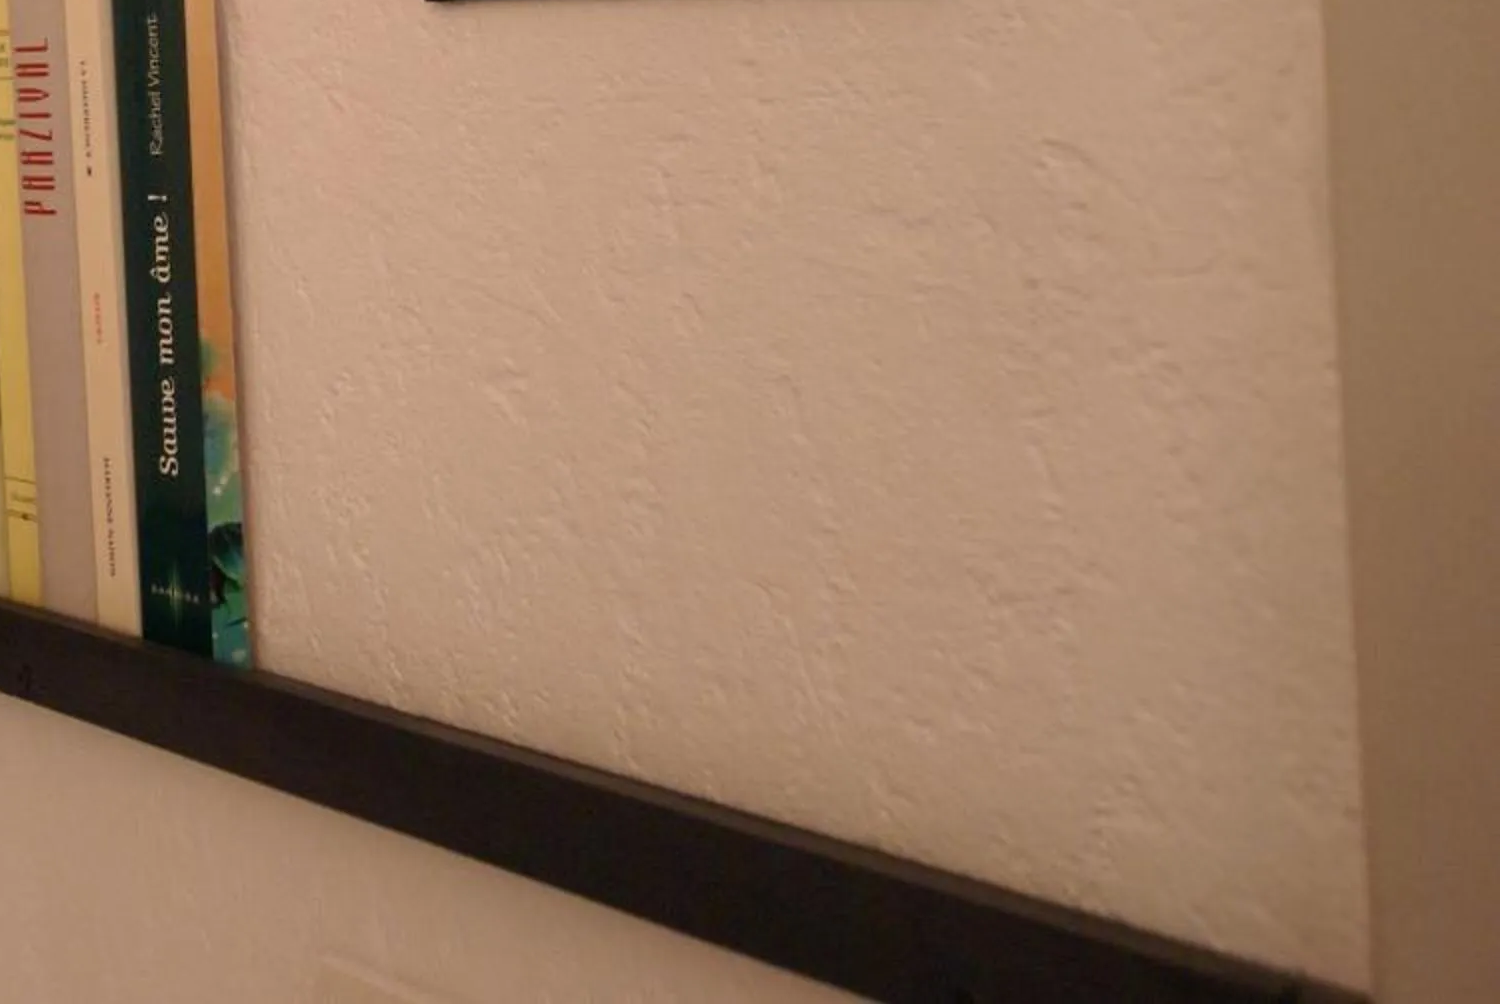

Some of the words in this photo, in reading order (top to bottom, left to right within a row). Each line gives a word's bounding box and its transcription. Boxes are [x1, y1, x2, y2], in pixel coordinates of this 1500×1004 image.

[147, 12, 161, 88] Vincent
[148, 90, 165, 156] Rachel
[149, 214, 171, 284] âme
[156, 293, 175, 365] mon
[159, 378, 179, 477] Sauve
